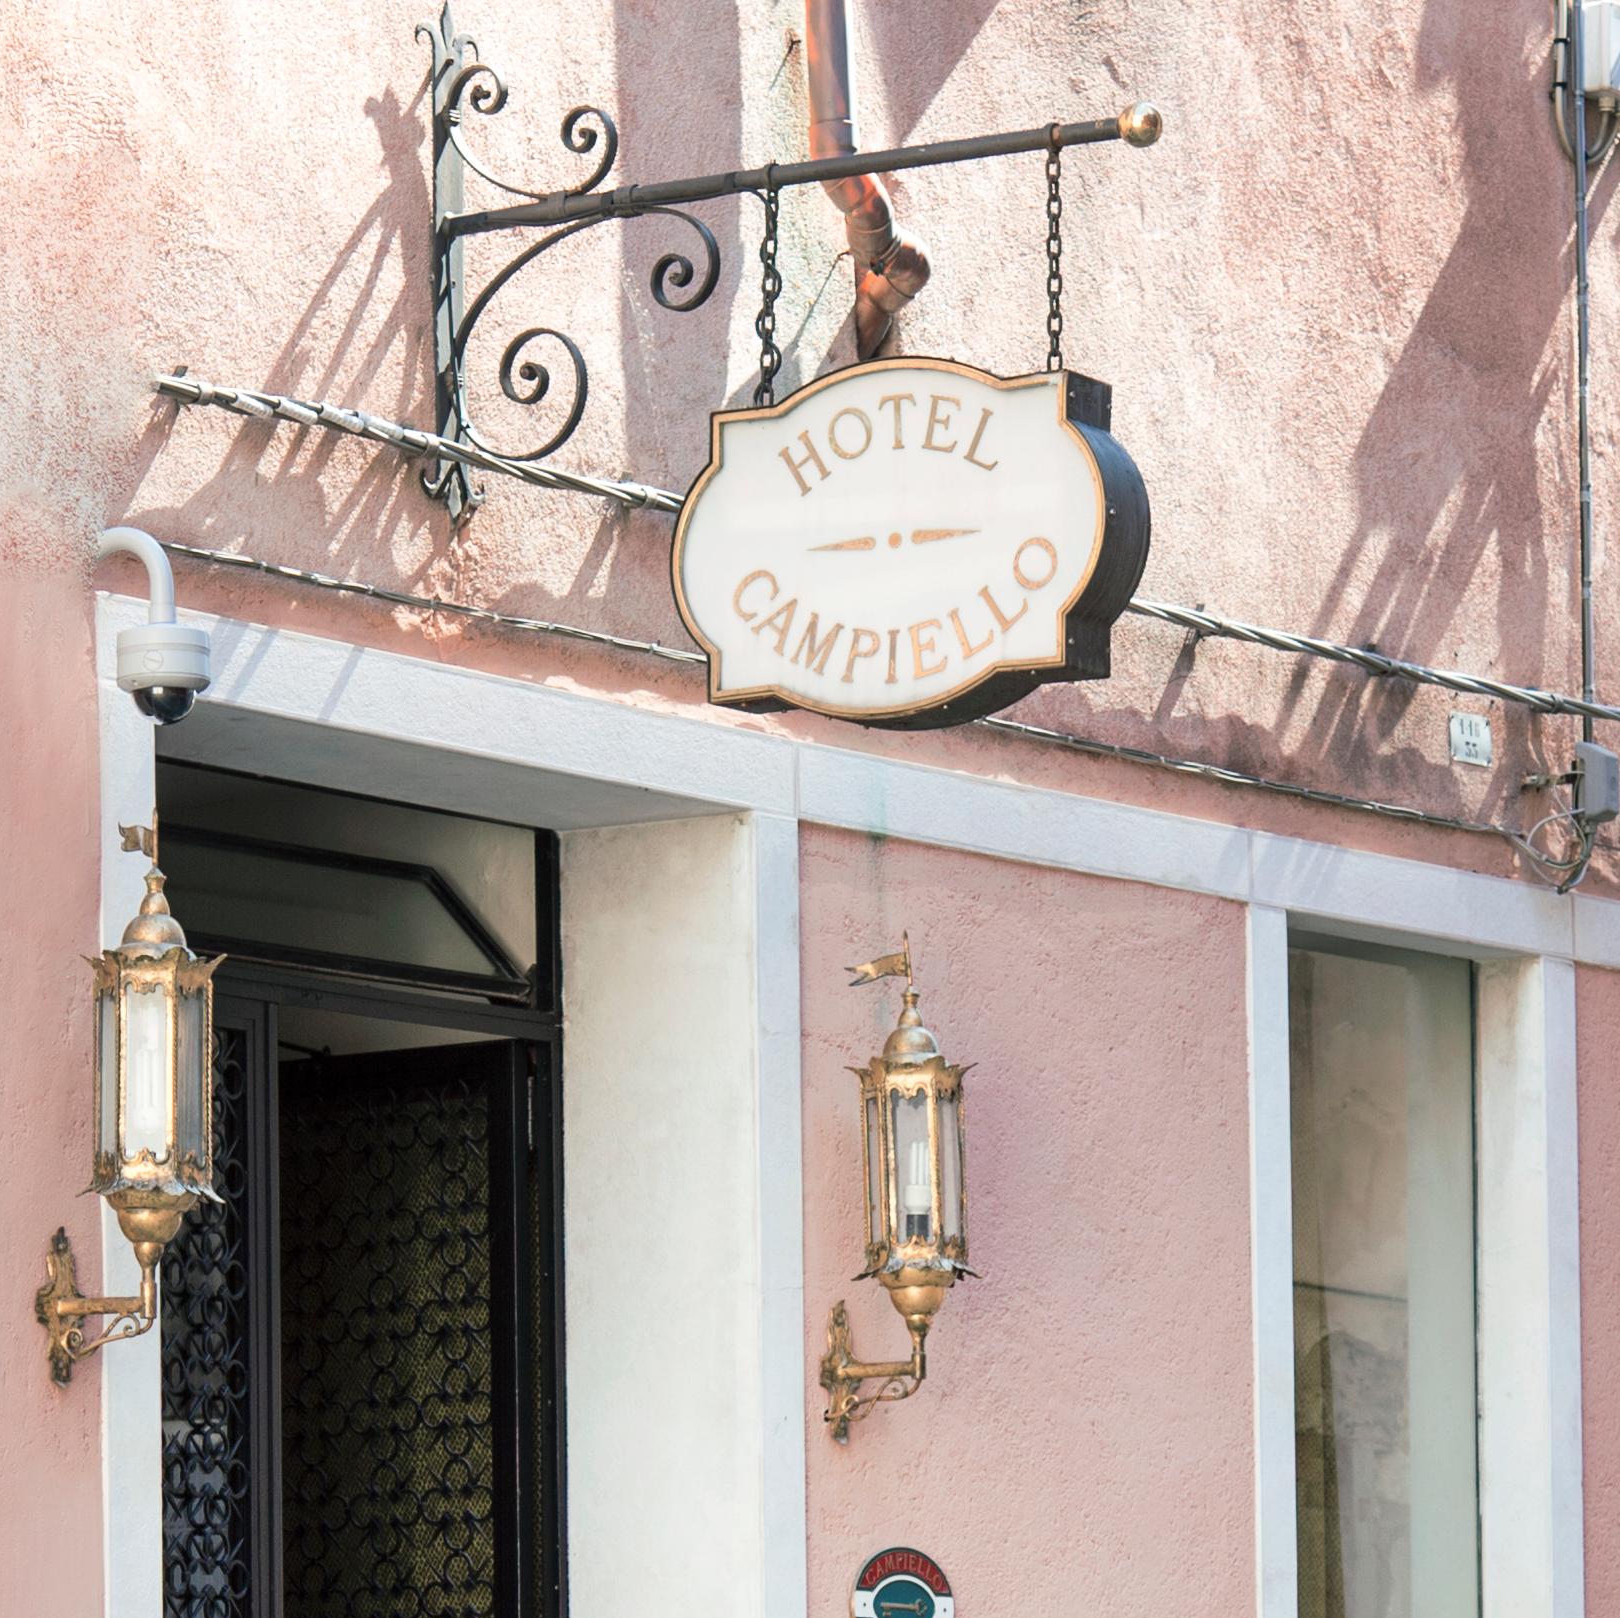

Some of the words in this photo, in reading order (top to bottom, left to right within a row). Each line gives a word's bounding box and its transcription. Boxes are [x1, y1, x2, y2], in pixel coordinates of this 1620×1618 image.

[778, 393, 999, 497] HOTEL
[732, 536, 1058, 685] CAMPIELLO
[865, 1552, 944, 1591] CAMPIELLO
